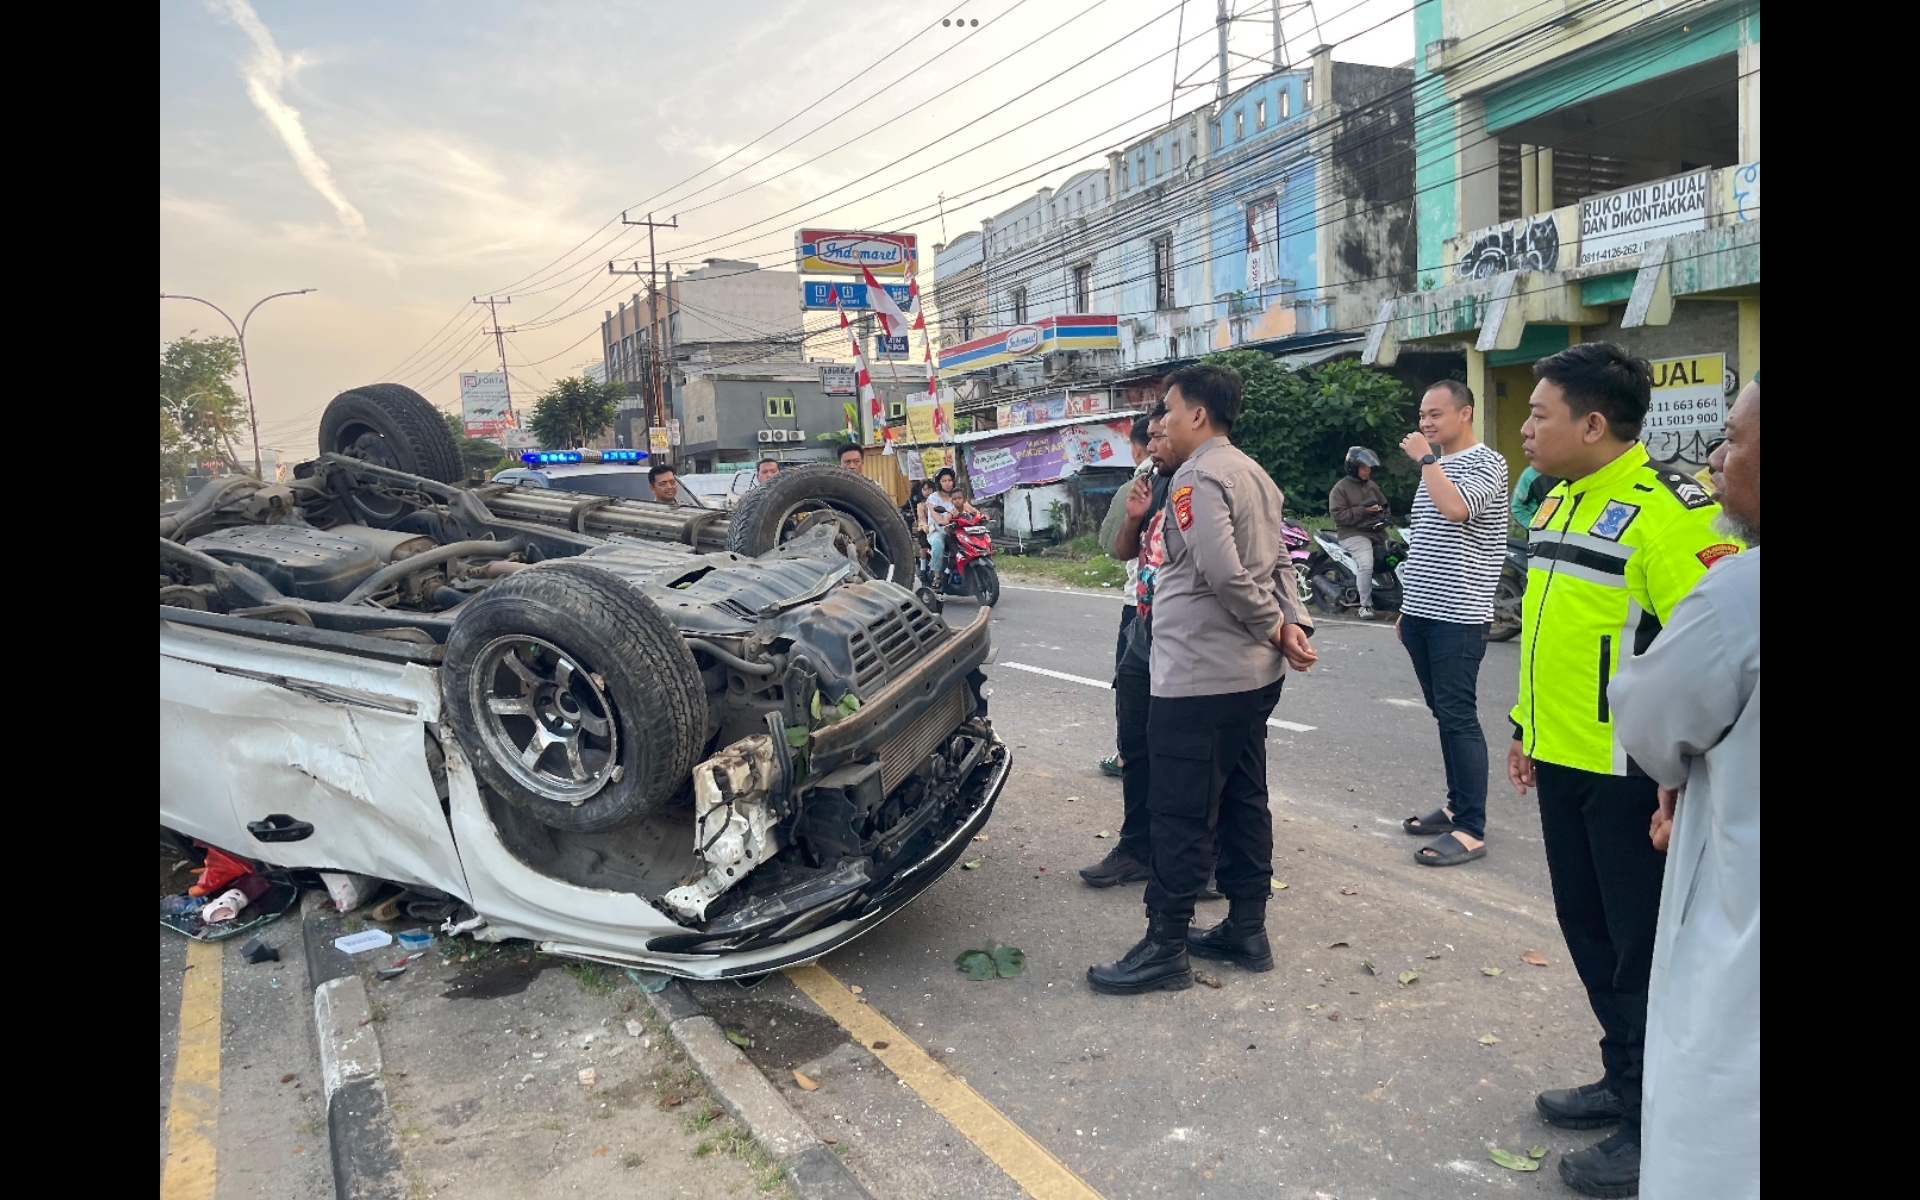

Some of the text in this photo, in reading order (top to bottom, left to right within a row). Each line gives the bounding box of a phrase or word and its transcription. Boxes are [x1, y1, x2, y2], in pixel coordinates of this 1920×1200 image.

[1584, 174, 1705, 219] RUKO INI DIJUAL
[1583, 191, 1705, 236] DAN DIKONTAKKAN
[823, 242, 898, 261] Indomaret
[1651, 361, 1704, 388] UAL
[1673, 399, 1693, 411] 663
[1696, 398, 1717, 410] 664
[1666, 414, 1694, 426] 5019
[1696, 412, 1718, 424] 900
